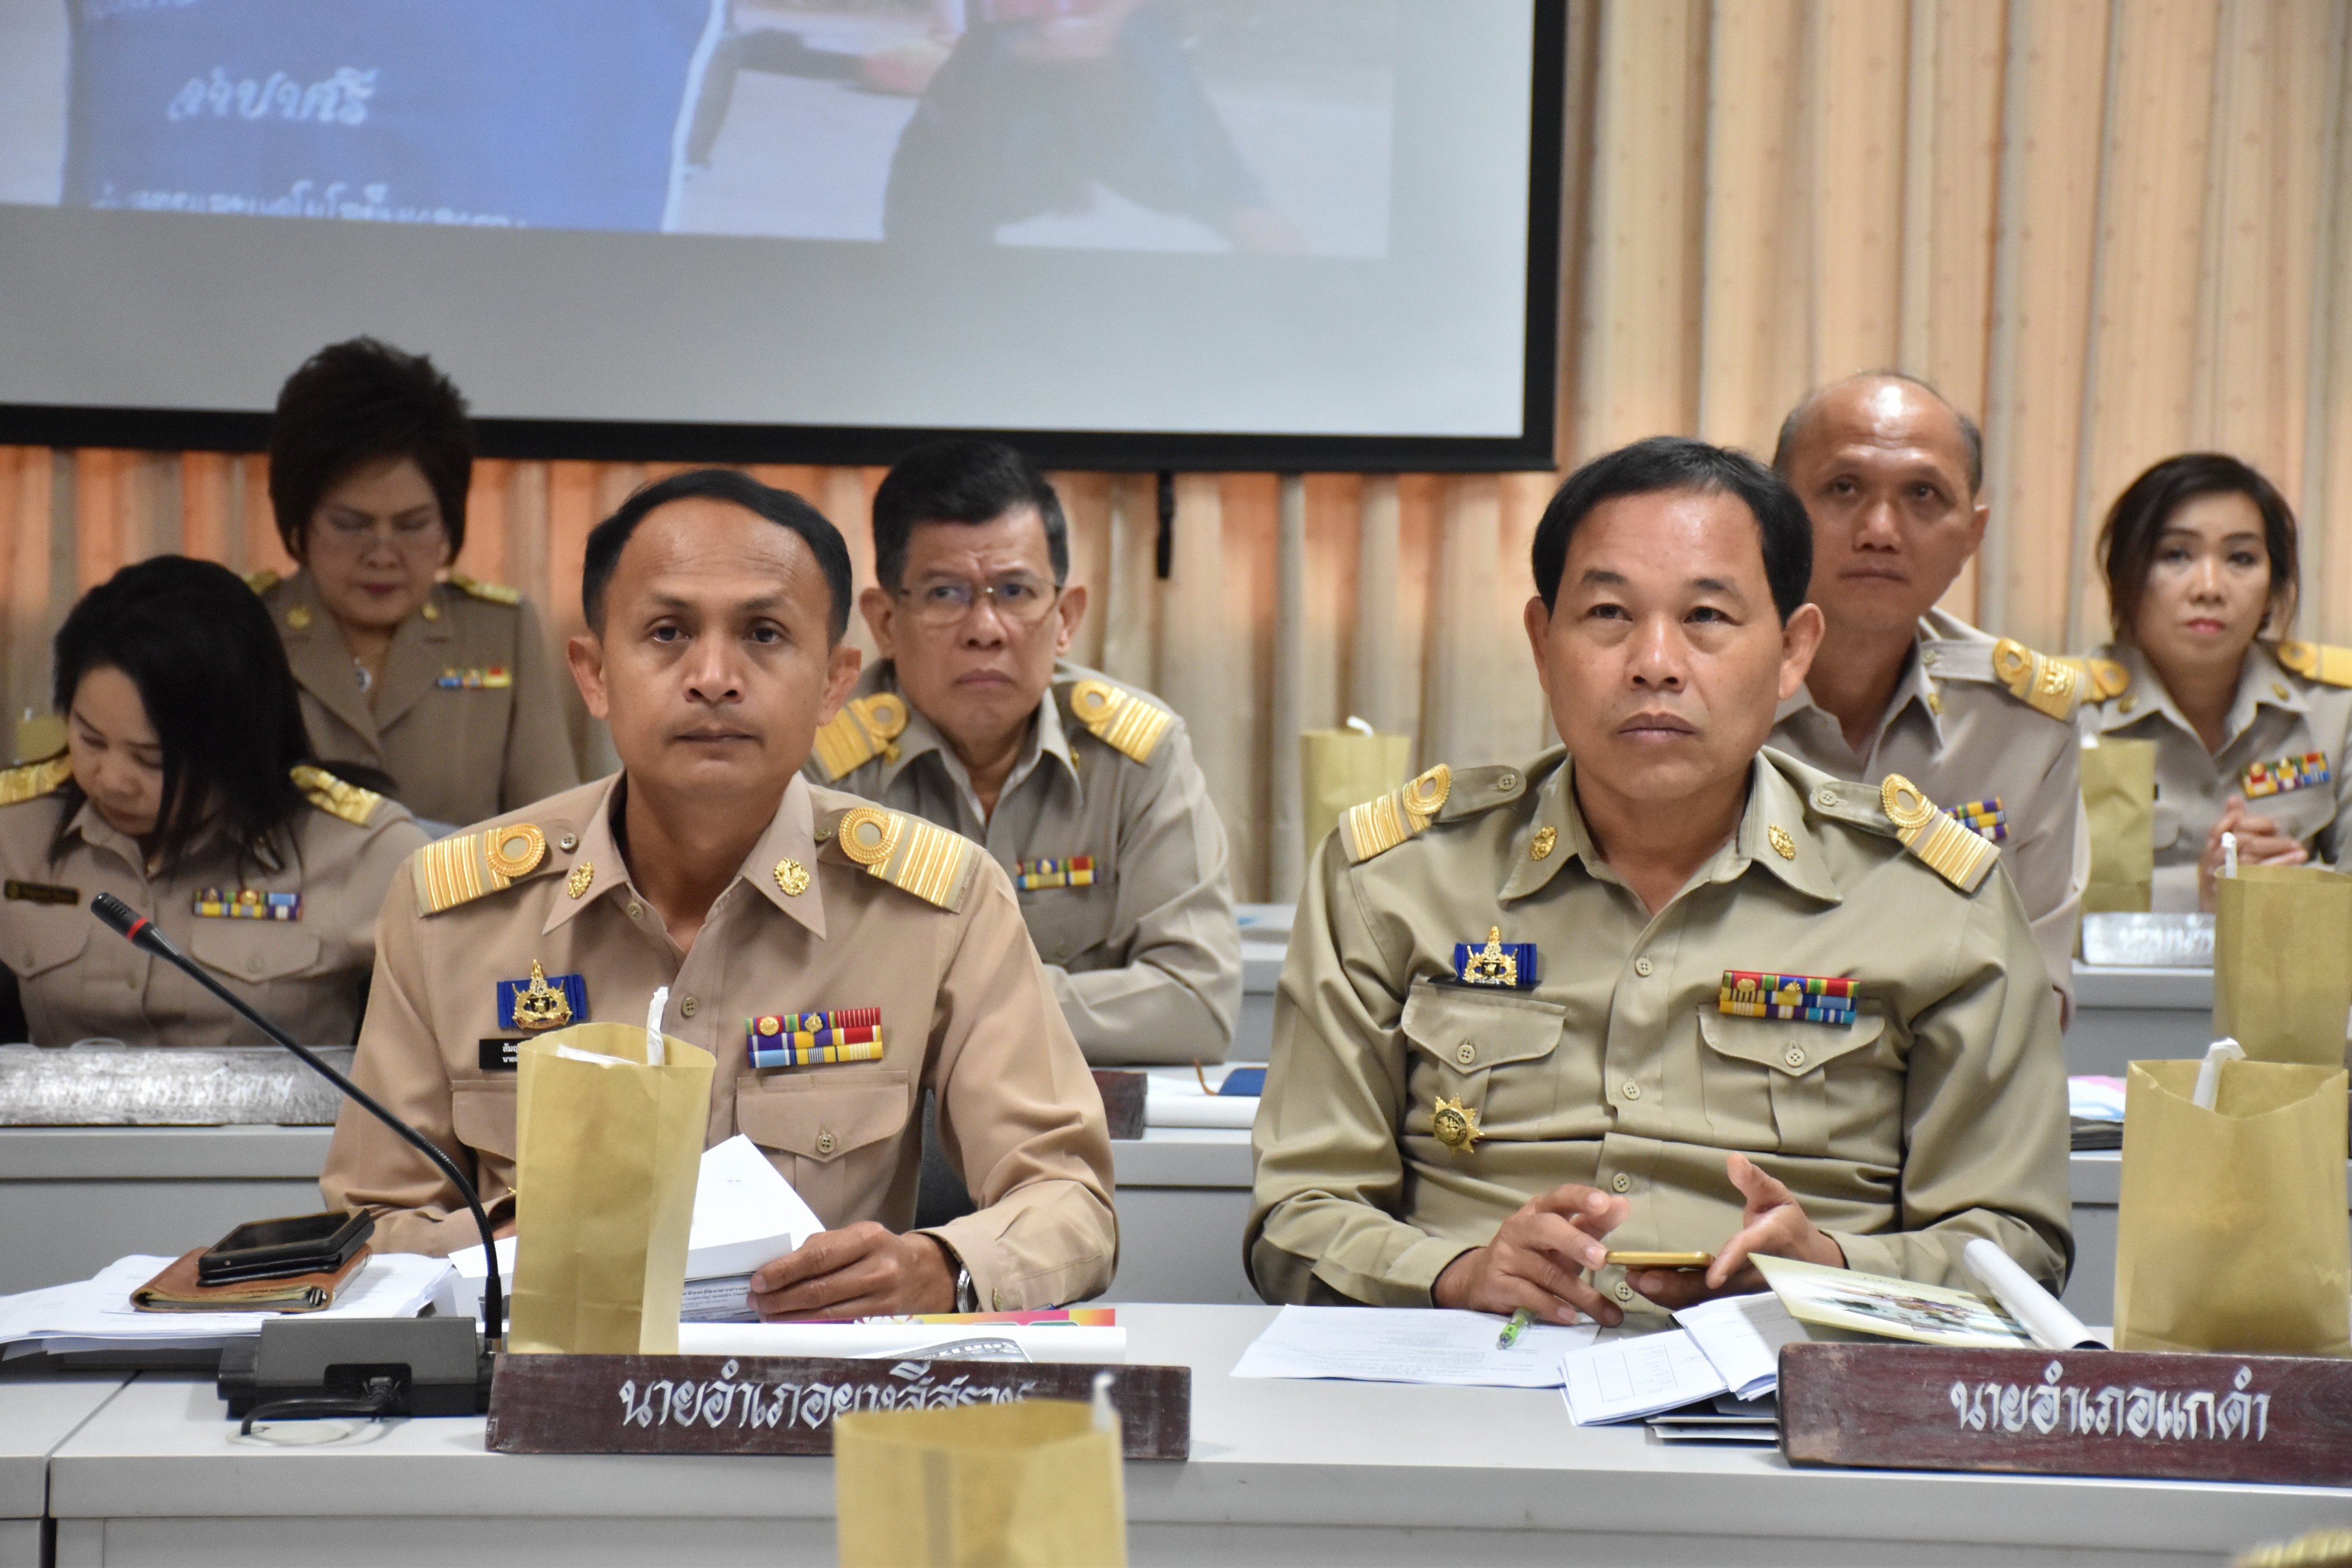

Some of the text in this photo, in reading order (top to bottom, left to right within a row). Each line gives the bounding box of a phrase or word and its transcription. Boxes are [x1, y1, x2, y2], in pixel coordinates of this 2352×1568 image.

[1950, 1360, 2271, 1441] นายอำเภอแกดำ
